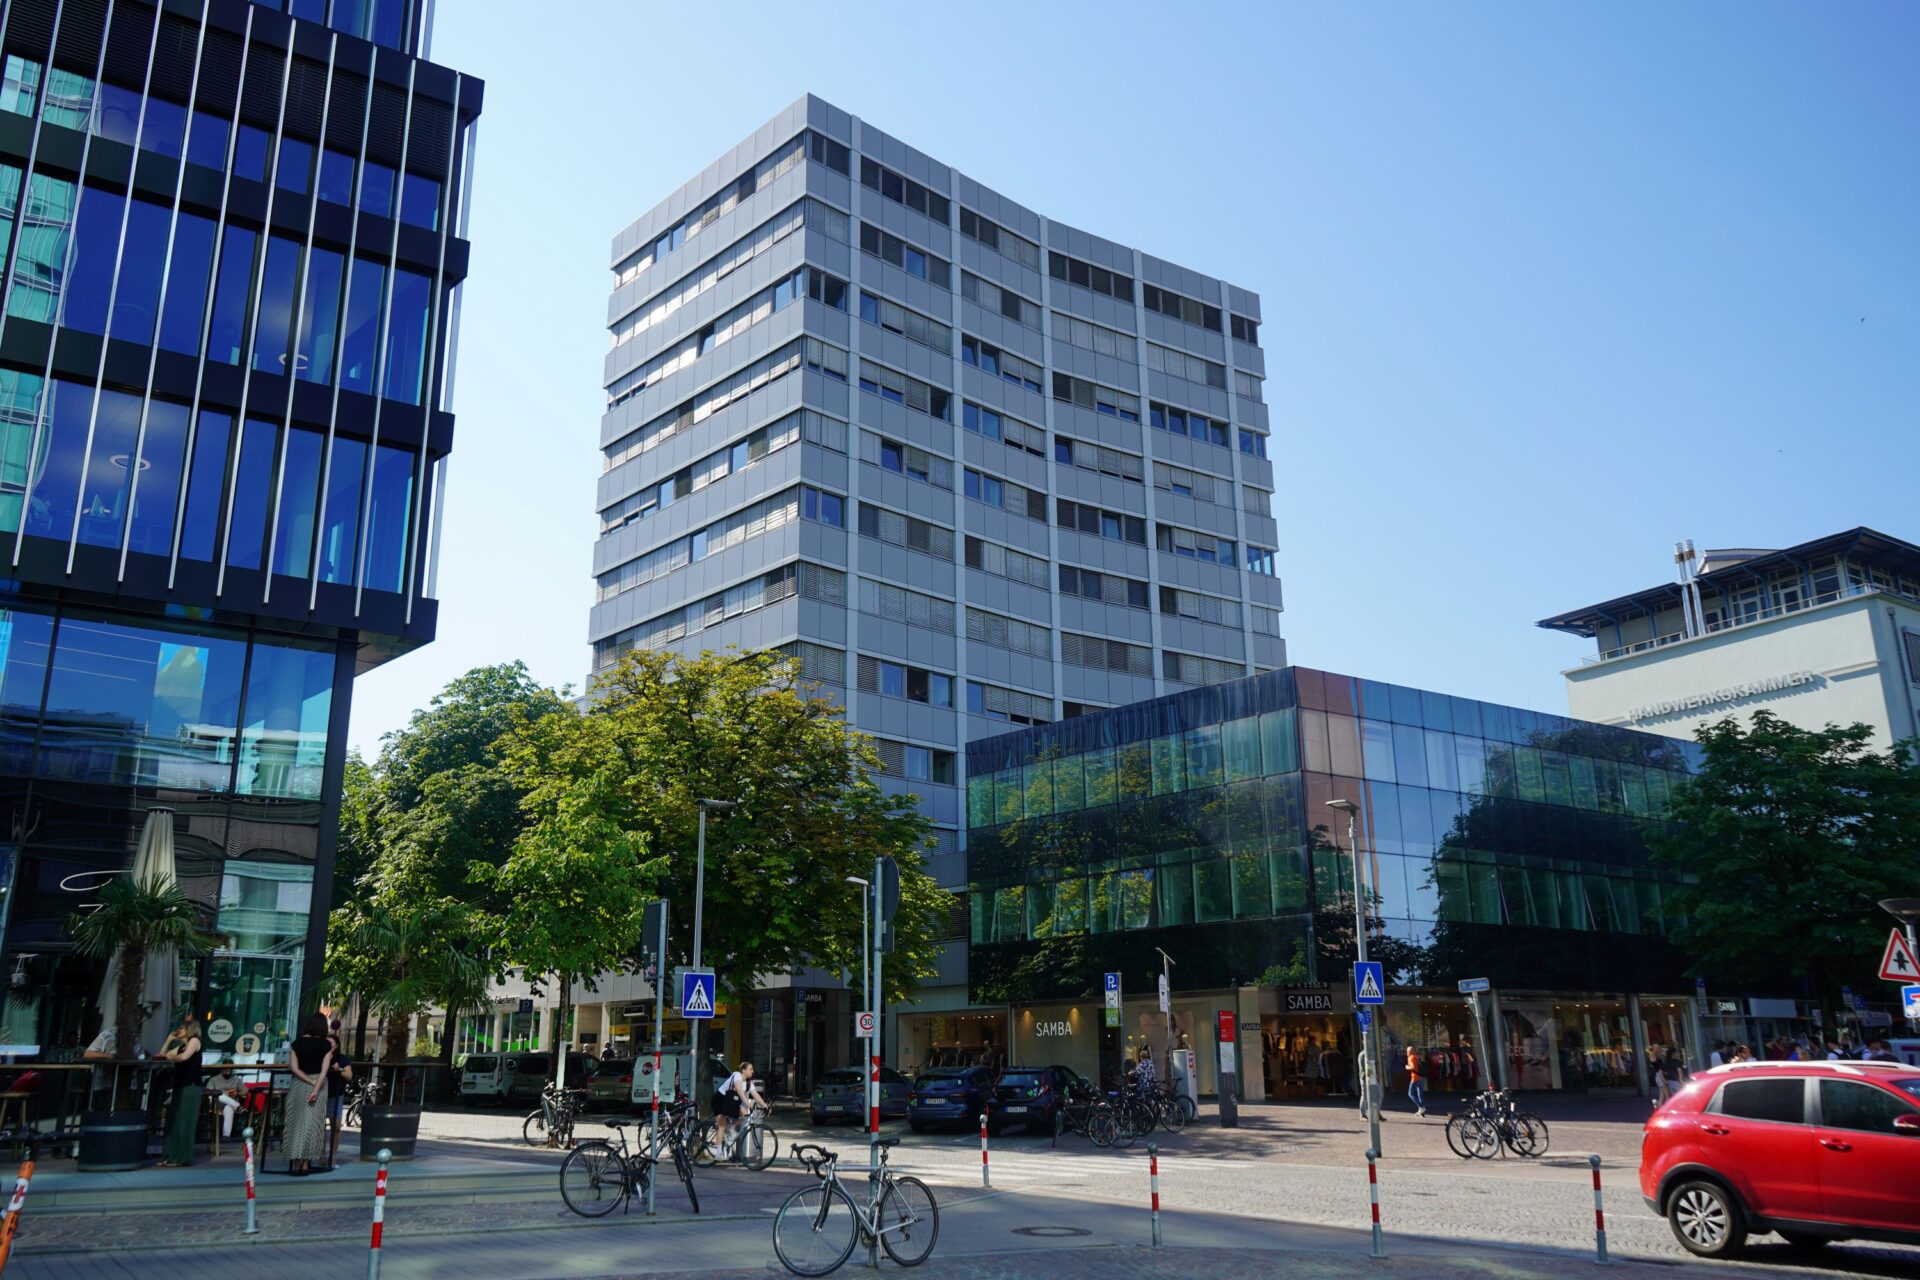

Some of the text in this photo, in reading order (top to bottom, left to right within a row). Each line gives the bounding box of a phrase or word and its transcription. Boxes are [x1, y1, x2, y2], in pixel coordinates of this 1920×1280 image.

[1628, 670, 1815, 722] HANDWERKSKAMMER
[806, 993, 822, 1002] AMBA
[1288, 995, 1331, 1010] SAMBA
[1718, 1002, 1736, 1012] SAMBA
[863, 1018, 872, 1026] 30
[1036, 1021, 1072, 1037] SAMBA
